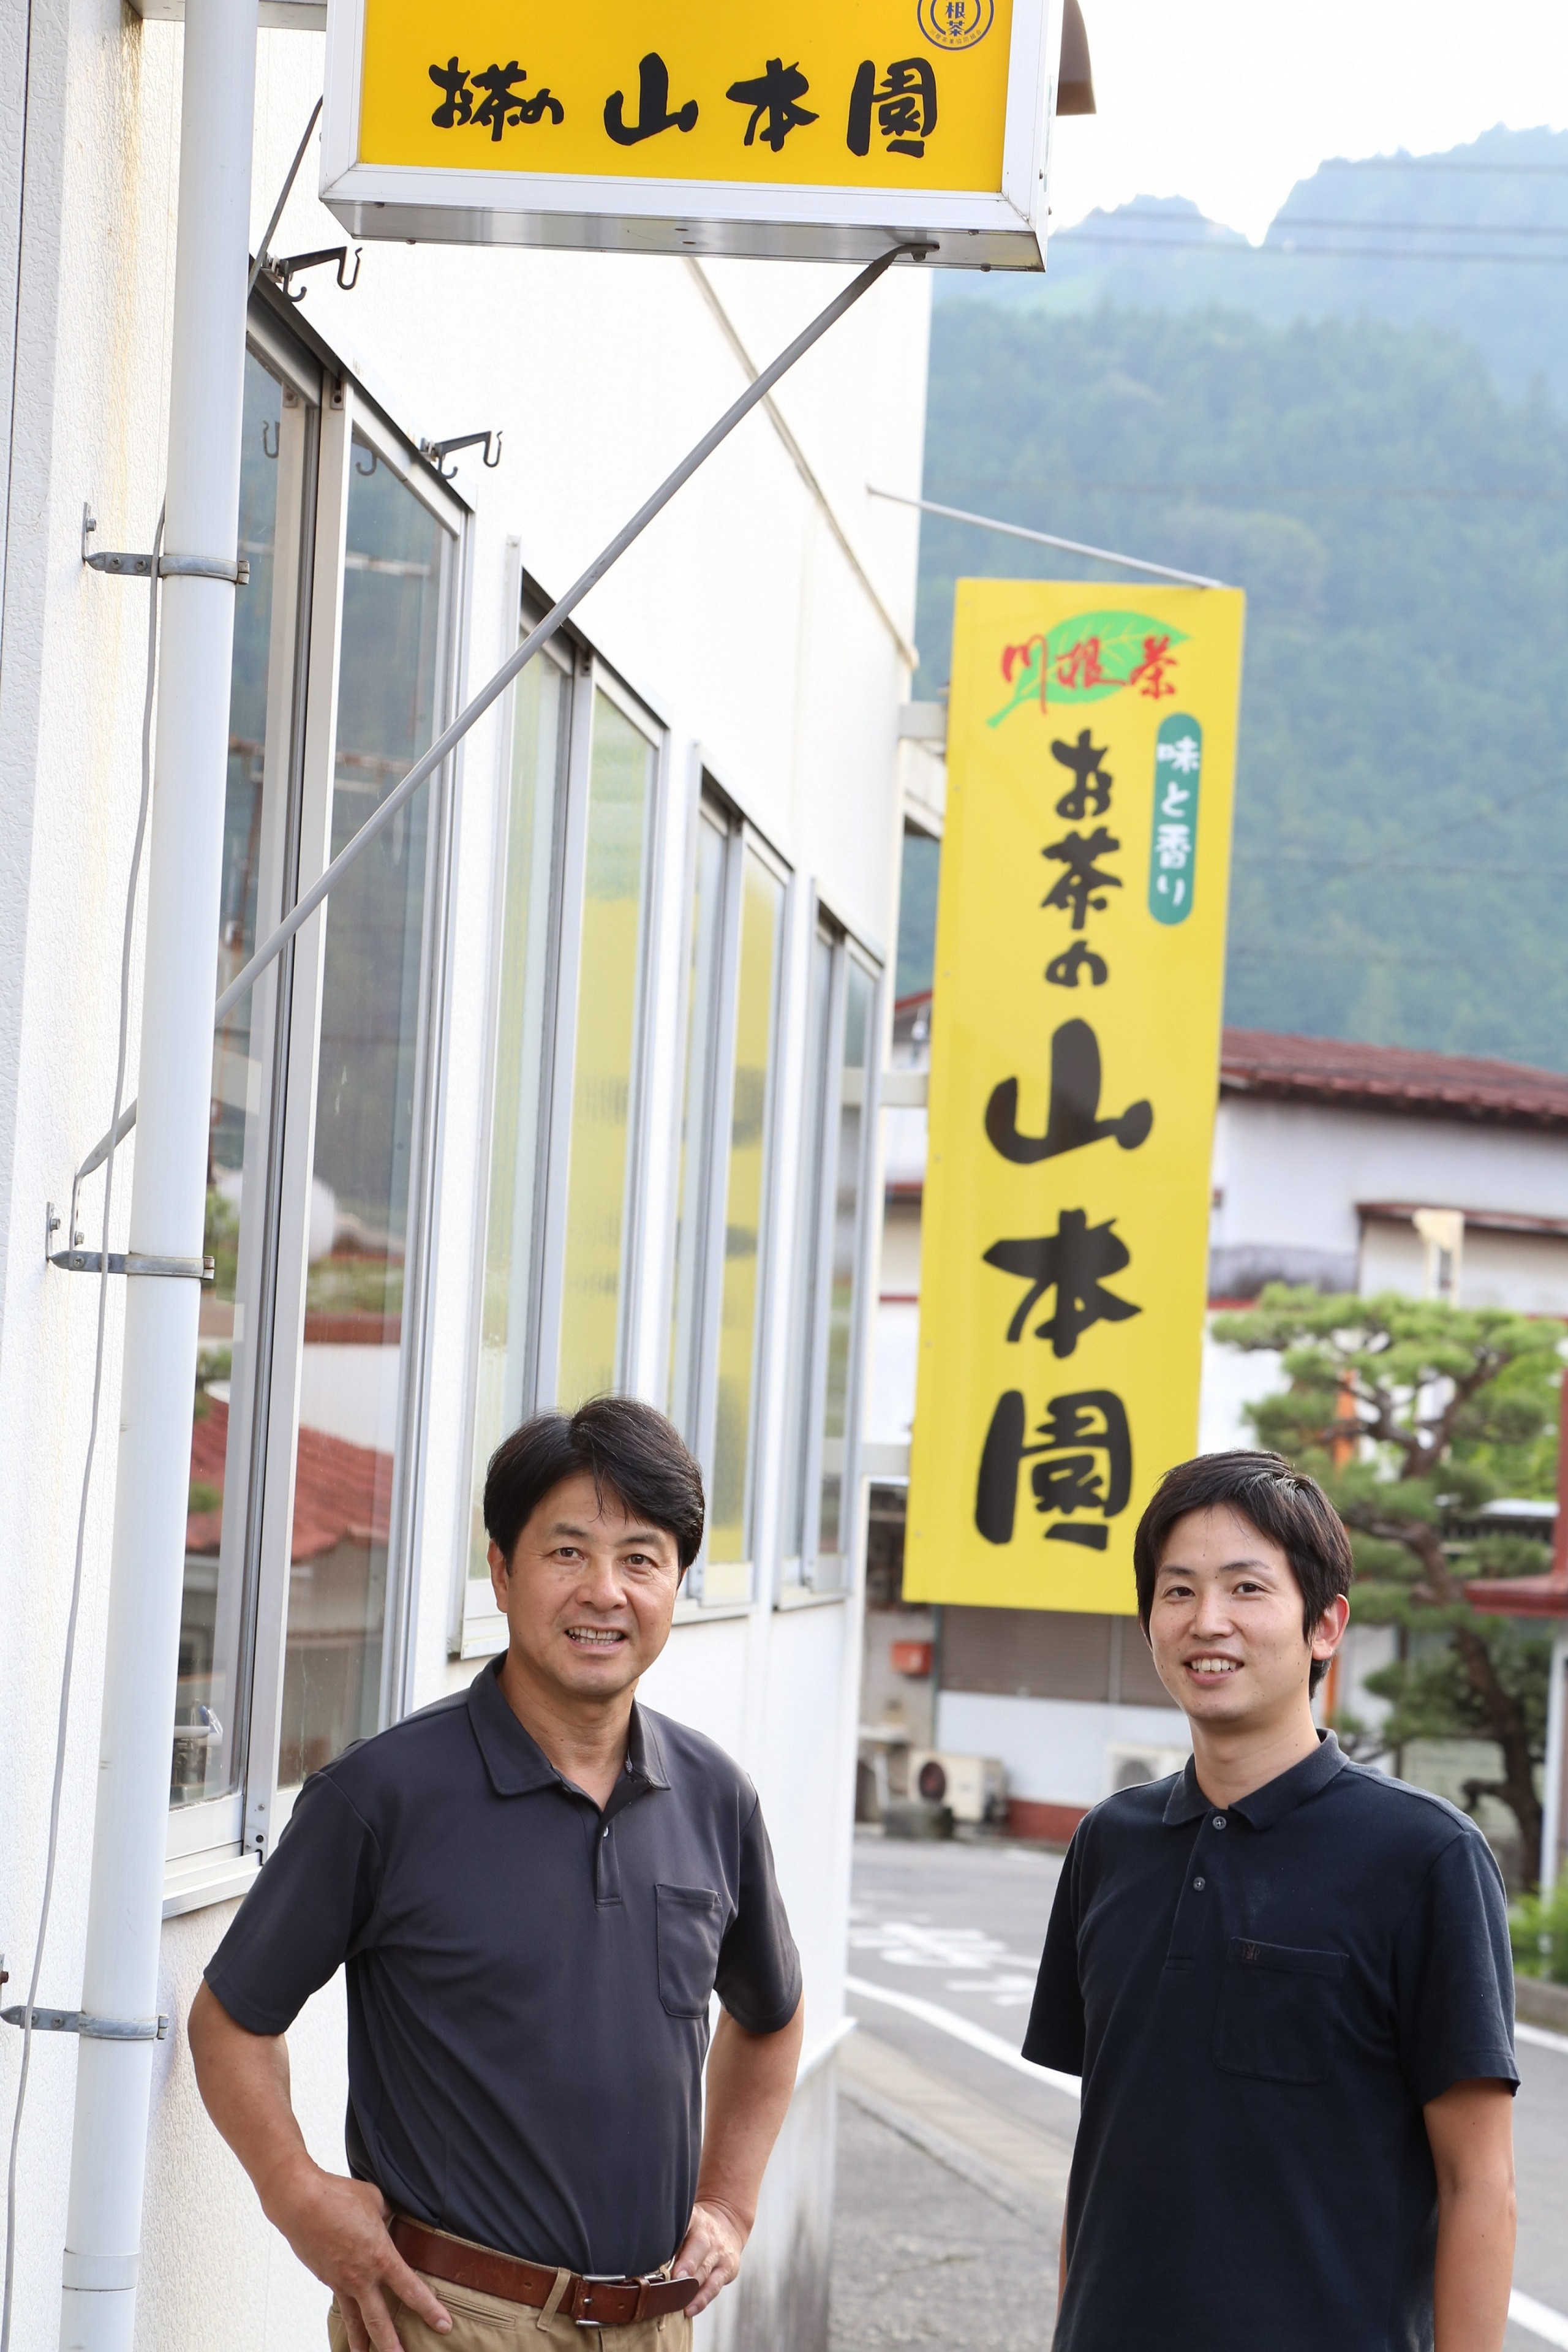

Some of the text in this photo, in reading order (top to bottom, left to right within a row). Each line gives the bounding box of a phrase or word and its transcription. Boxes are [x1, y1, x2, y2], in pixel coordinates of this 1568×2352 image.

[1001, 633, 1178, 715] 川根茶
[1155, 736, 1200, 907] 味と香り
